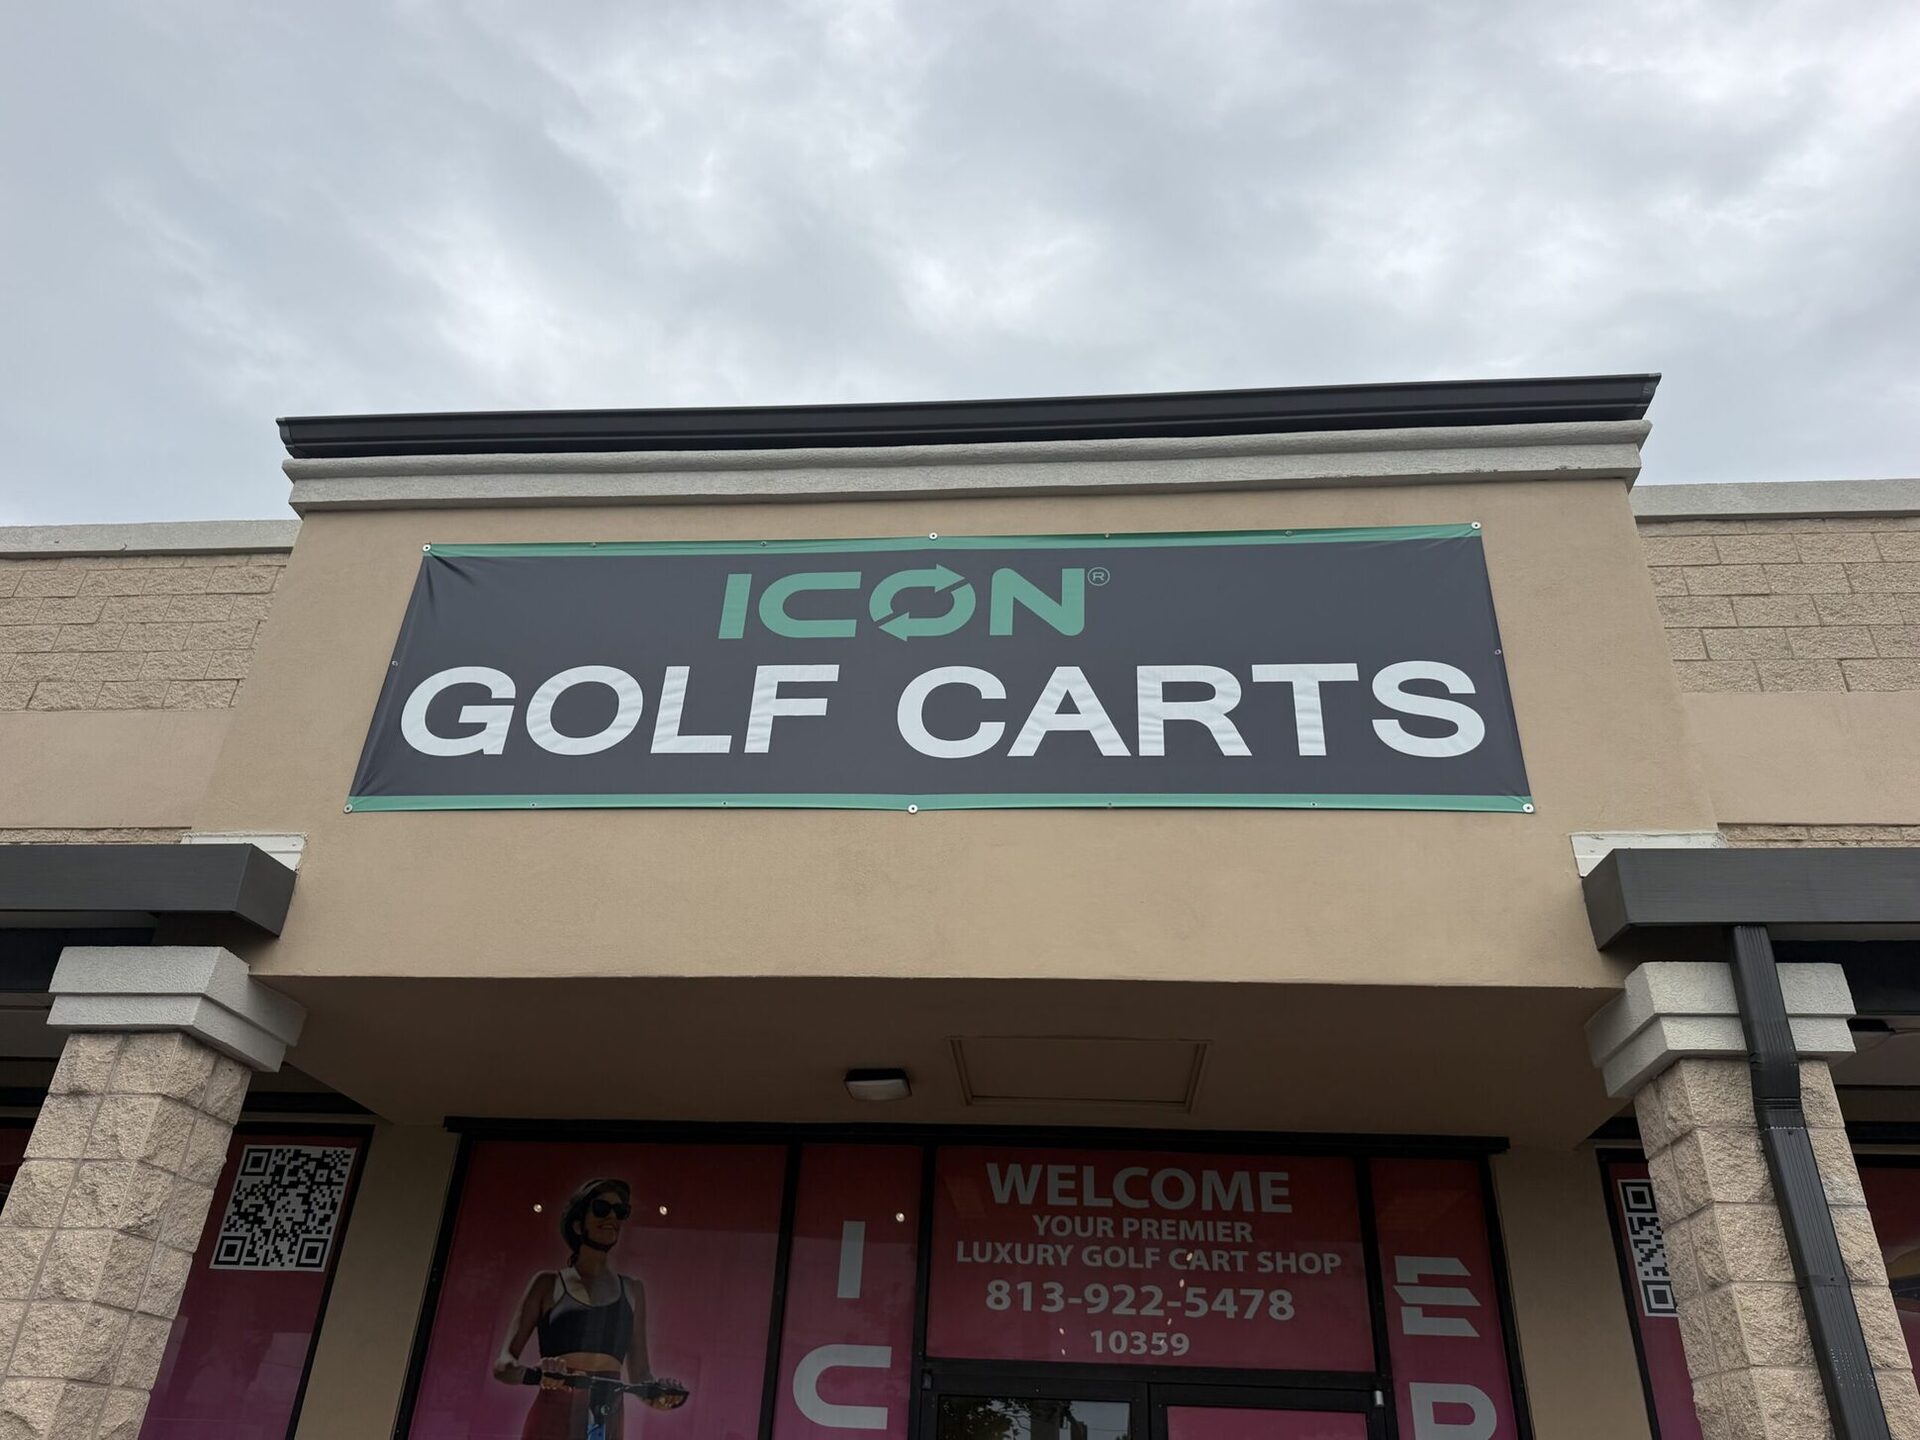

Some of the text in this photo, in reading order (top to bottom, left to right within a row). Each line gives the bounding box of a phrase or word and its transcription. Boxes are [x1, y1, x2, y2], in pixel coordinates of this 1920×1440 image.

[400, 660, 1487, 759] GOLF CARTS
[985, 1161, 1293, 1214] WELCOME
[1032, 1214, 1254, 1243] YOUR PREMIER
[956, 1241, 1342, 1275] LUXURY GOLF CART SHOP
[985, 1279, 1296, 1321] 813-922-5478
[1089, 1329, 1190, 1357] 10359
